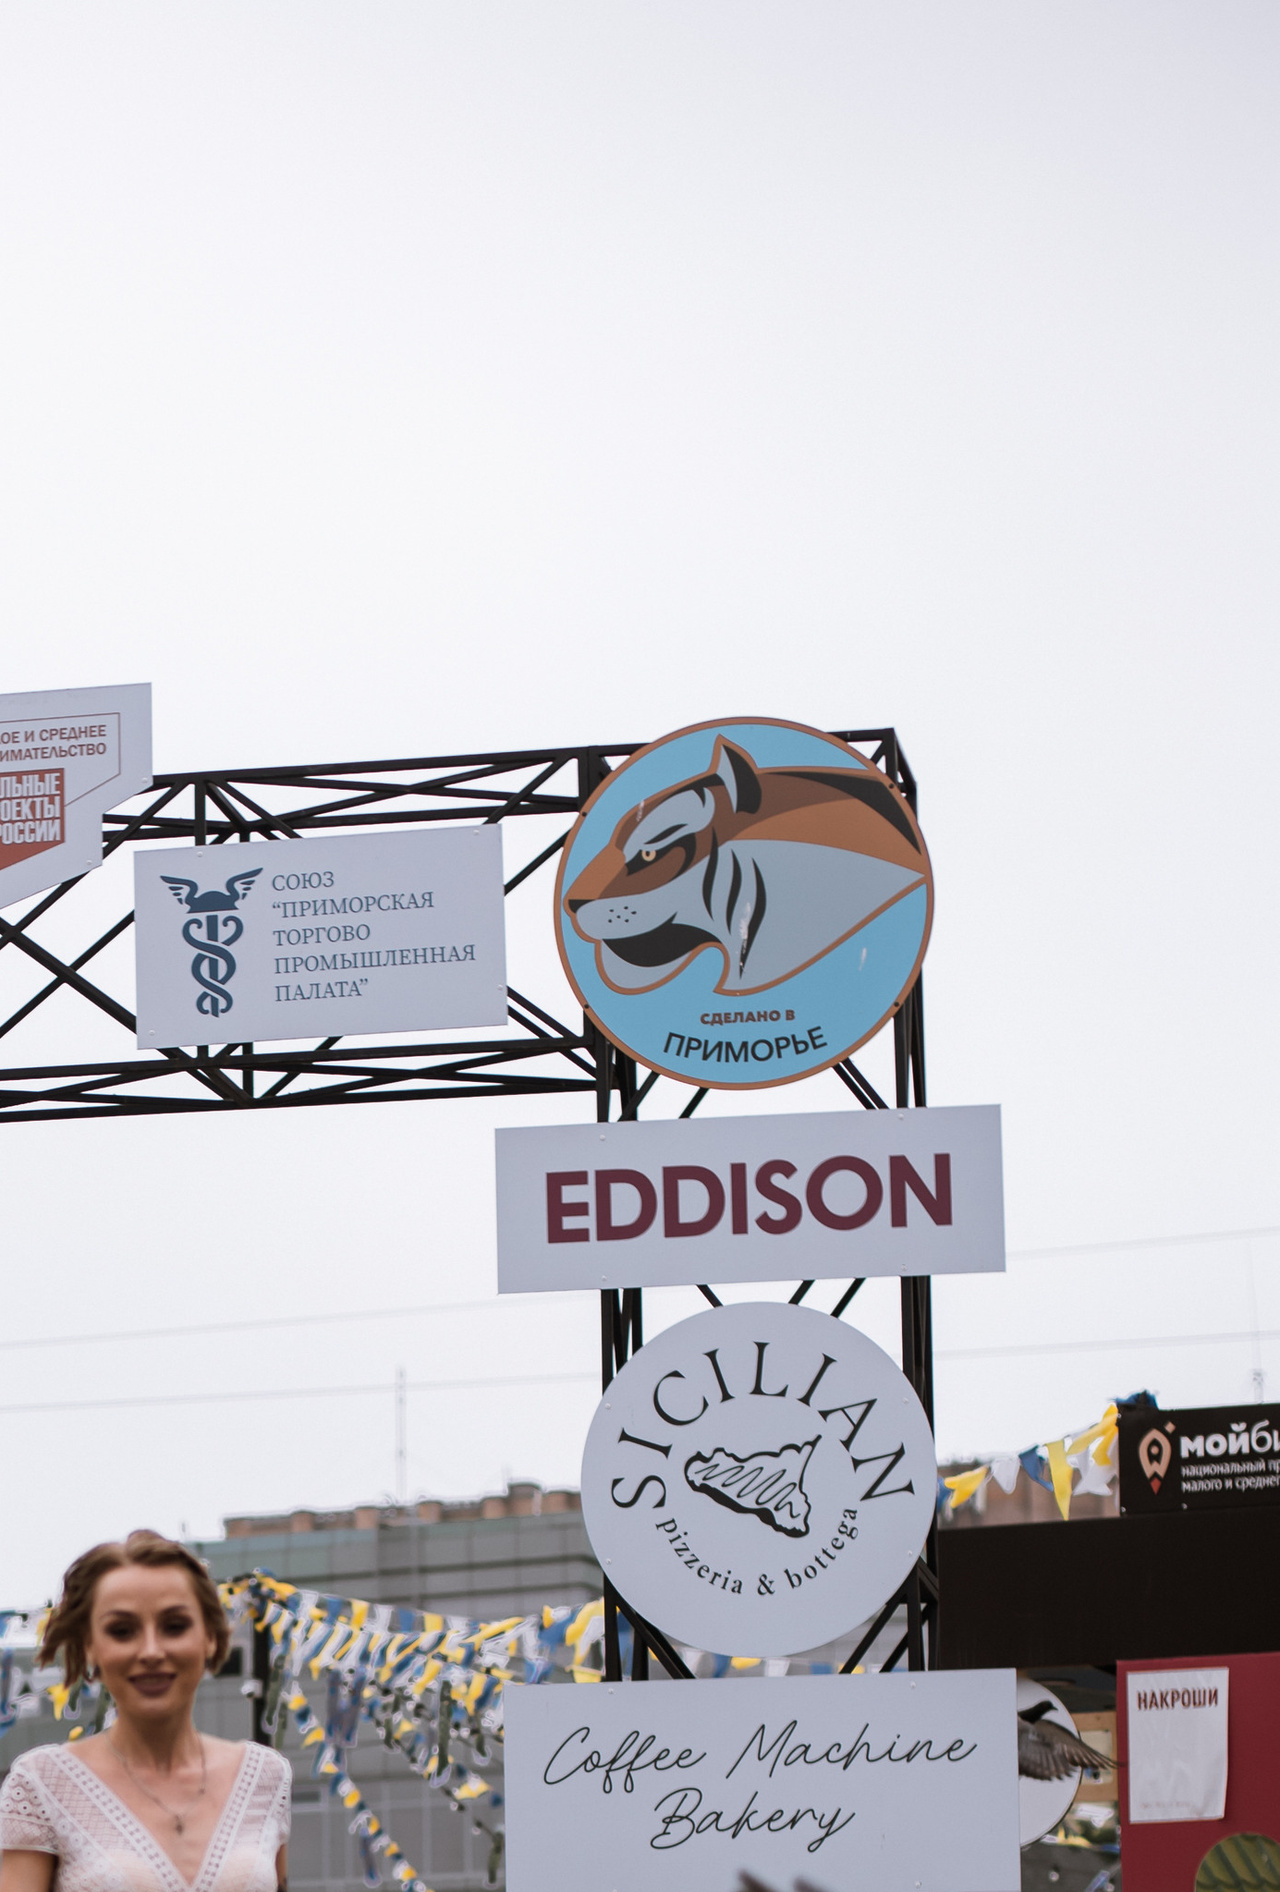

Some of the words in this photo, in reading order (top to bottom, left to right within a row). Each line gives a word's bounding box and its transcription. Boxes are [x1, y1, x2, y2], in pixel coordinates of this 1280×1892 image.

[24, 731, 34, 742] И
[39, 725, 107, 741] СРЕДНЕЕ
[272, 871, 334, 891] СОЮЗ
[273, 924, 370, 946] ТОРГОВО
[274, 944, 476, 974] ПРОМЫШЛЕННАЯ
[700, 1010, 781, 1026] СДЕЛАНО
[785, 1009, 795, 1021] В
[663, 1026, 828, 1063] ПРИМОРЬЕ
[546, 1153, 953, 1245] EDDISON
[611, 1341, 915, 1509] SICILIAN
[1181, 1458, 1266, 1477] национальный
[1181, 1478, 1223, 1493] малого
[1224, 1479, 1233, 1489] и
[655, 1518, 743, 1594] pizzeria
[757, 1573, 775, 1596] &
[784, 1507, 859, 1588] bottega
[1137, 1687, 1218, 1711] НАКРОШИ
[544, 1727, 707, 1793] Coffee
[726, 1720, 978, 1779] Machine
[650, 1788, 855, 1852] Bakery
